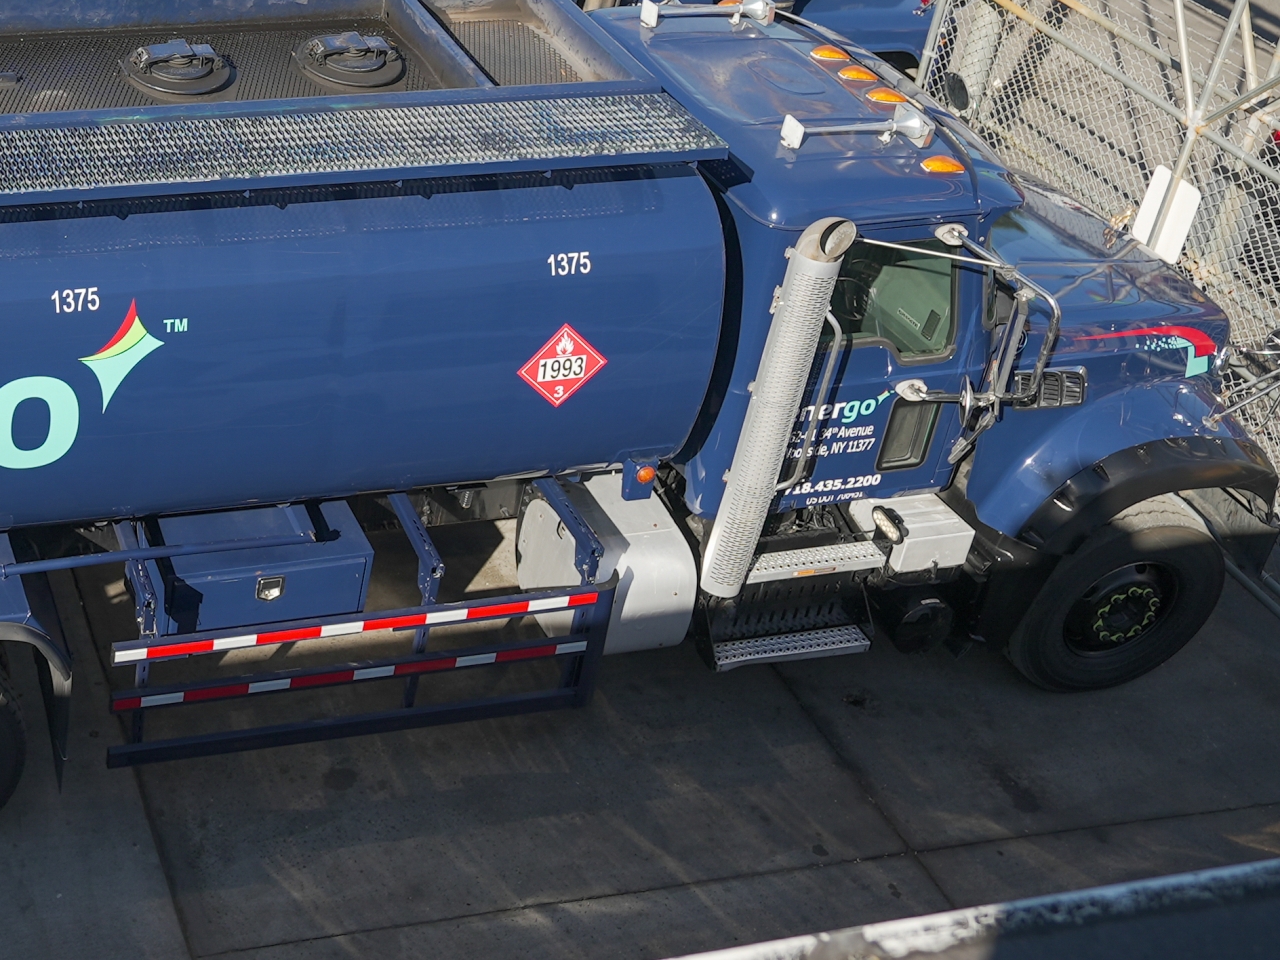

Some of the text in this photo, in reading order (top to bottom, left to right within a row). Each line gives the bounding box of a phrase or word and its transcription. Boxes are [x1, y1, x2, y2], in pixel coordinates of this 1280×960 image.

[547, 251, 591, 276] 1375
[51, 286, 101, 315] 1375
[163, 318, 188, 332] TM
[540, 356, 584, 380] 1993
[553, 386, 564, 398] 3
[800, 398, 877, 424] nergo
[837, 425, 874, 439] Avenue
[830, 441, 848, 454] NY
[846, 438, 876, 454] 11377
